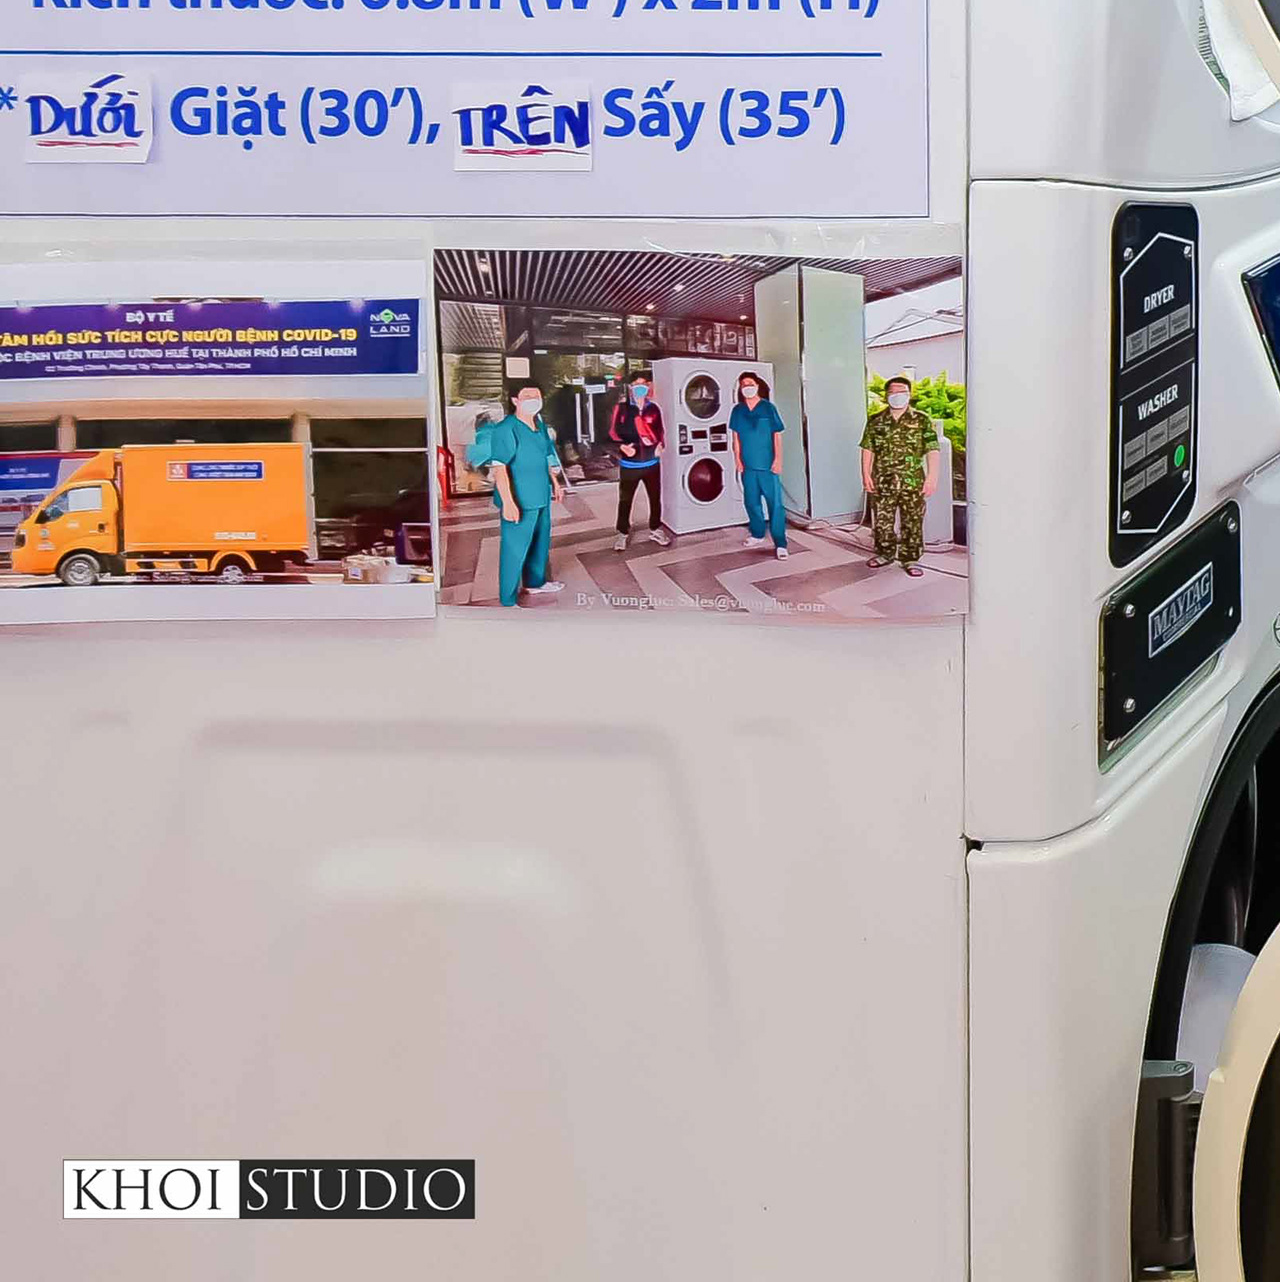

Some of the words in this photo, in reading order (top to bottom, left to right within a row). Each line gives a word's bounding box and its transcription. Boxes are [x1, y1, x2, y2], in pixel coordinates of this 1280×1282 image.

[169, 85, 287, 150] Giặt
[456, 83, 591, 150] TRÊN
[603, 78, 706, 152] Sấy
[1143, 283, 1176, 314] DRYER
[125, 311, 145, 324] BỘ
[158, 309, 175, 322] TẾ
[369, 324, 411, 334] LAND
[105, 328, 143, 343] TÍCH
[236, 327, 278, 345] BỆNH
[282, 328, 358, 342] COVID-19
[301, 344, 322, 357] CHÍ
[1137, 383, 1179, 421] WASHER
[1153, 571, 1211, 640] MAYTAG
